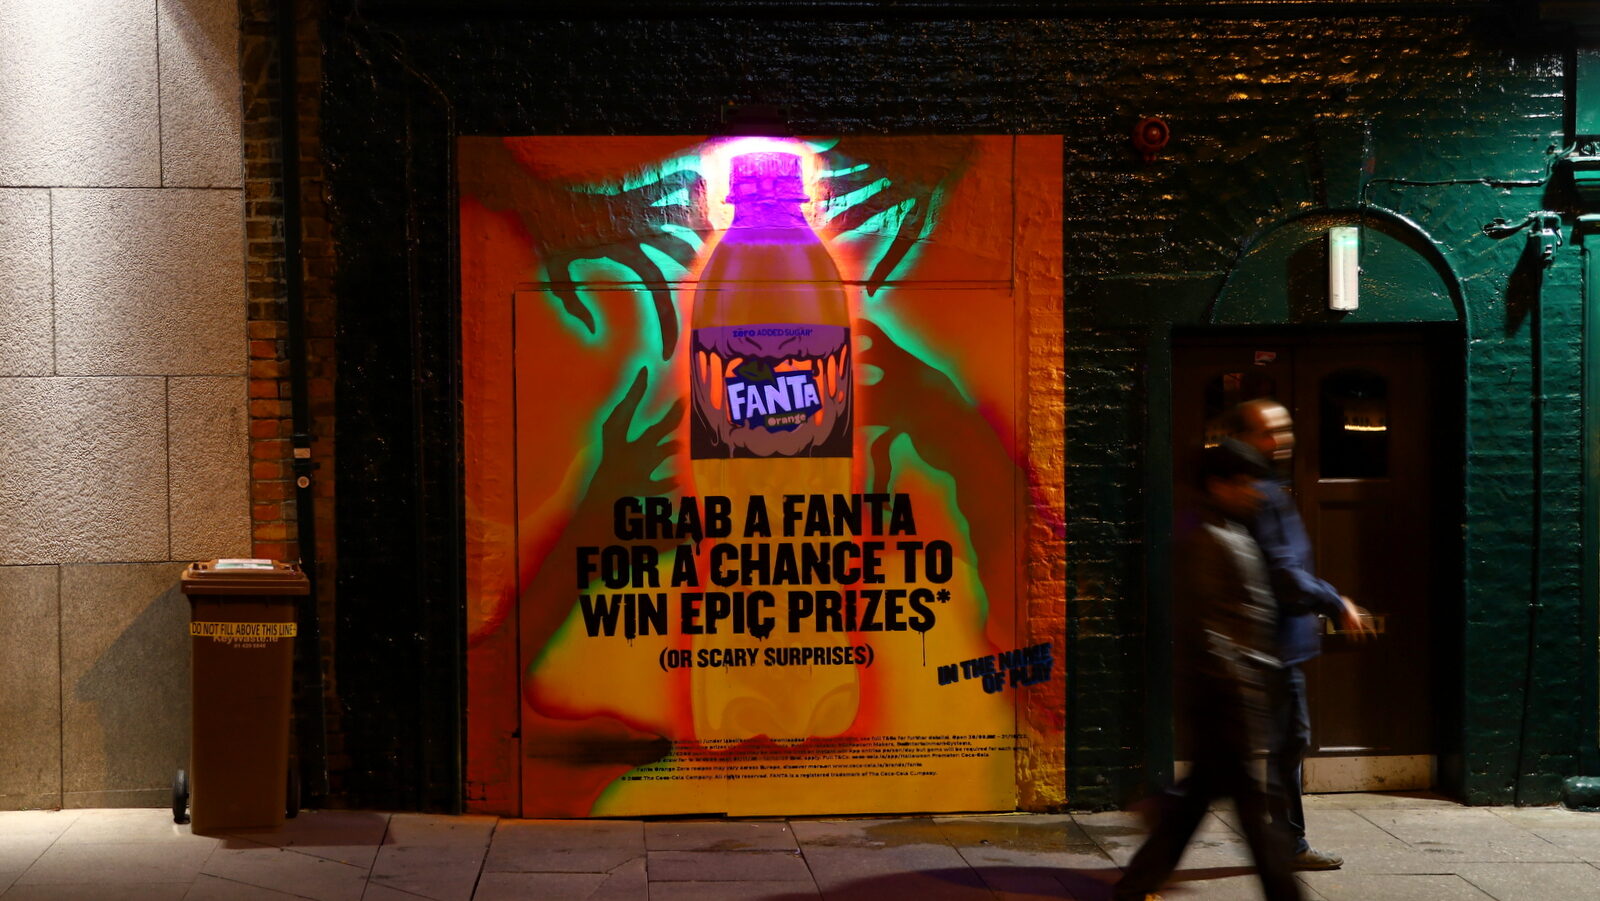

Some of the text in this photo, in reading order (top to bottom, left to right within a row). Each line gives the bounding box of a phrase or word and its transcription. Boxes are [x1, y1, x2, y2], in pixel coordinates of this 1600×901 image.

[733, 329, 756, 338] zero
[757, 328, 784, 336] ADDED
[727, 374, 820, 421] FANTA
[767, 414, 807, 427] Orange
[613, 493, 917, 542] GRAB A FANTA
[576, 540, 953, 590] FOR A CHANCE TO
[191, 622, 201, 634] DO
[203, 623, 219, 635] NOT
[220, 623, 235, 635] FILL
[236, 623, 262, 636] ABOVE
[262, 624, 278, 636] THIS
[579, 593, 668, 639] WIN
[680, 591, 776, 637] EPIC
[659, 644, 875, 672] (OR SCARY SURPRISES)
[937, 643, 1052, 686] IN THE NAME
[982, 662, 1052, 694] OF PLAY
